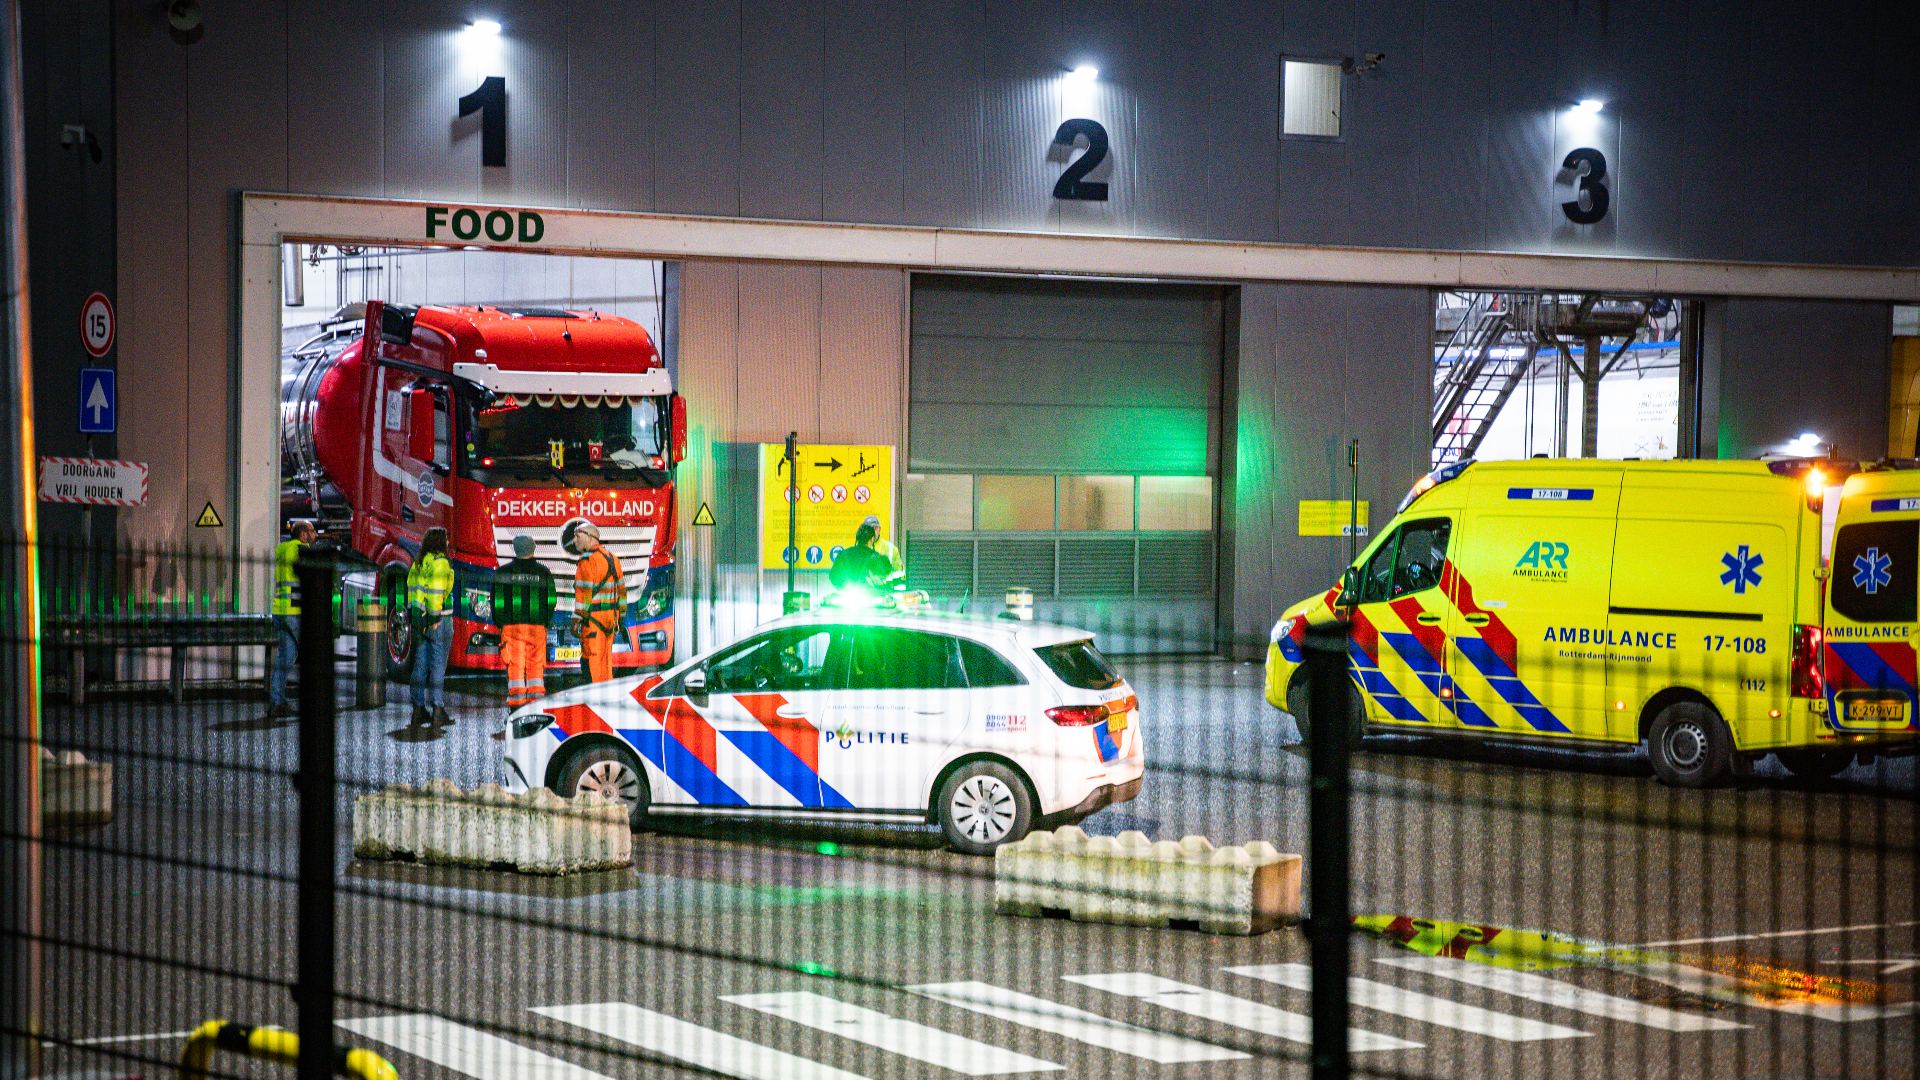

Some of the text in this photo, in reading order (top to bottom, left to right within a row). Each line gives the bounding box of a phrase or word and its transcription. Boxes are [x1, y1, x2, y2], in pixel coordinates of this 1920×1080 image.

[459, 76, 506, 168] 1
[1053, 118, 1109, 202] 2
[1561, 147, 1610, 225] 3
[426, 206, 545, 243] FOOD
[90, 314, 106, 339] 15
[62, 464, 116, 479] DOORGANG
[55, 483, 123, 499] VRIJ HOUDEN
[1538, 490, 1563, 498] 17-108
[497, 500, 566, 517] DEKKER
[579, 500, 654, 516] HOLLAND
[204, 515, 214, 525] EX
[1515, 541, 1570, 570] ARR
[1512, 569, 1568, 579] AMBULANCE
[1543, 626, 1767, 654] AMBULANCE 17-108
[1825, 626, 1909, 638] AMBULANCE
[1559, 650, 1652, 663] Rotterdam-Rijnmond
[1746, 679, 1766, 691] 112
[1852, 703, 1899, 717] K-299-VT
[1008, 715, 1027, 725] 112
[825, 730, 909, 750] POLITIE
